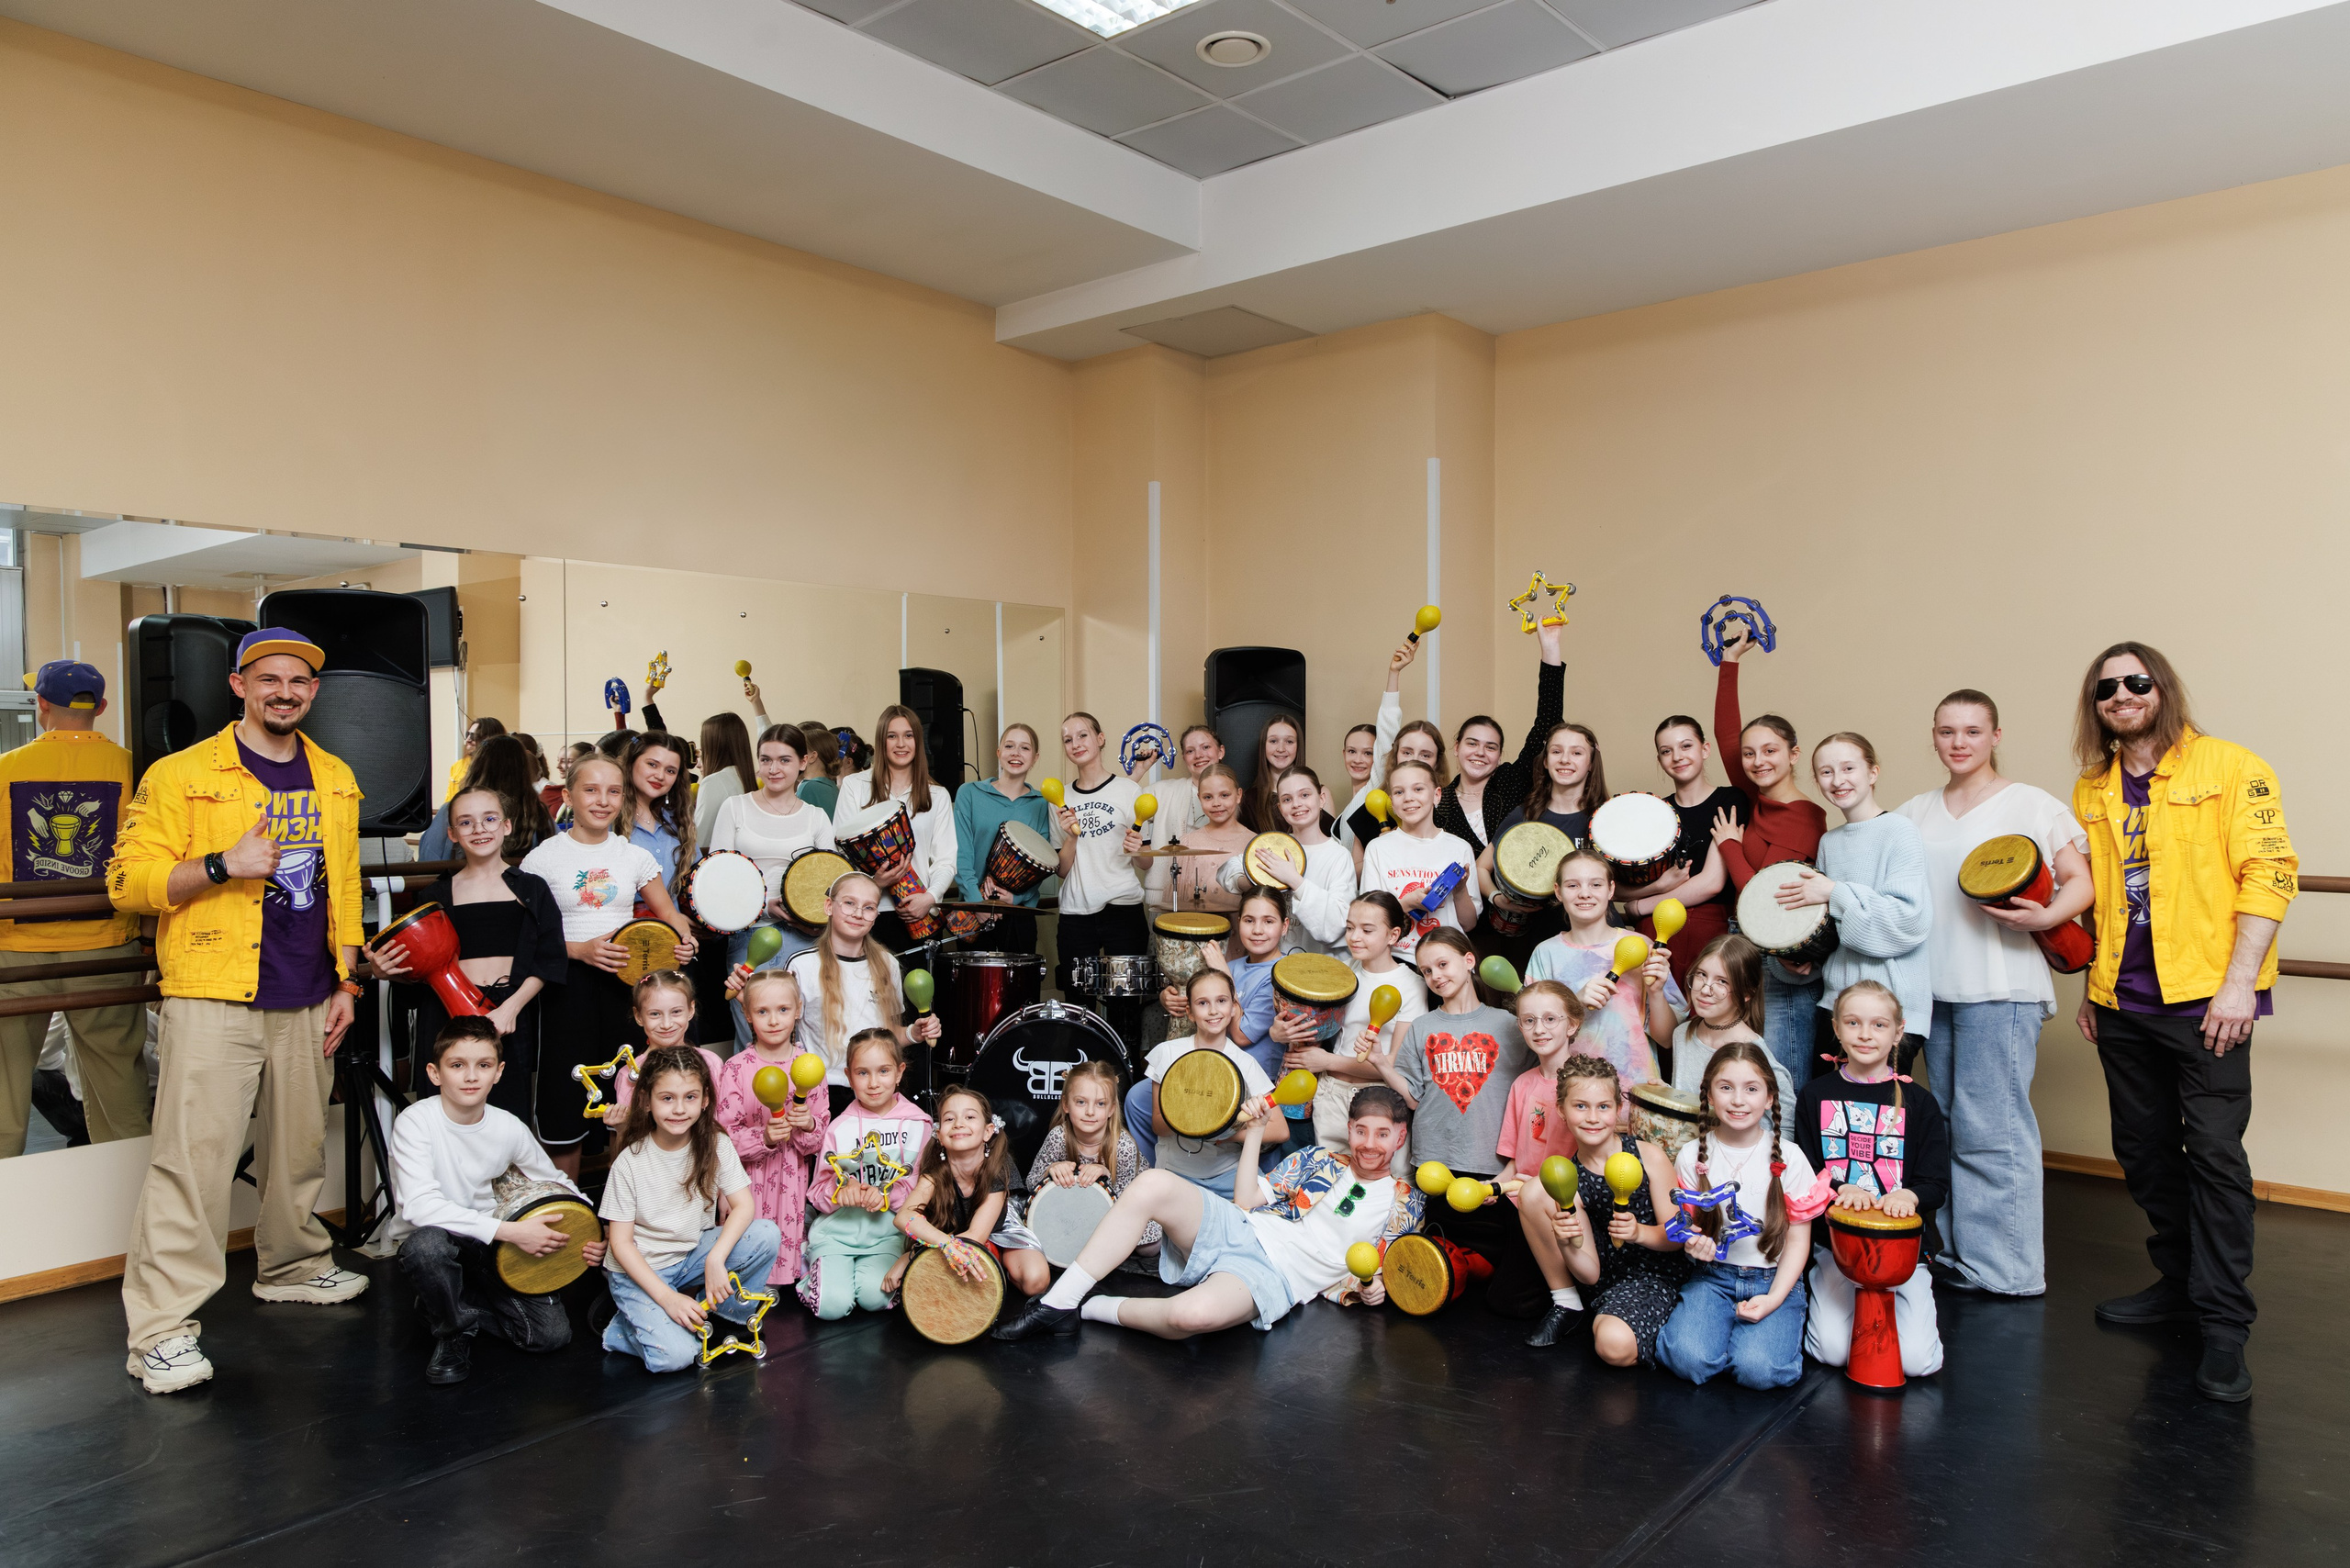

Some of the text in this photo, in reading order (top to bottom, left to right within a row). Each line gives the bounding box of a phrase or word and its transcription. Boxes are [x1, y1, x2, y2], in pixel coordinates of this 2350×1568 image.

[1073, 801, 1114, 814] ILFIGER
[1078, 816, 1101, 829] 1985
[1090, 821, 1116, 837] YORK
[1434, 1052, 1487, 1074] NIRVANA
[1851, 1141, 1871, 1149] YOUR
[1851, 1148, 1871, 1158] VIBE
